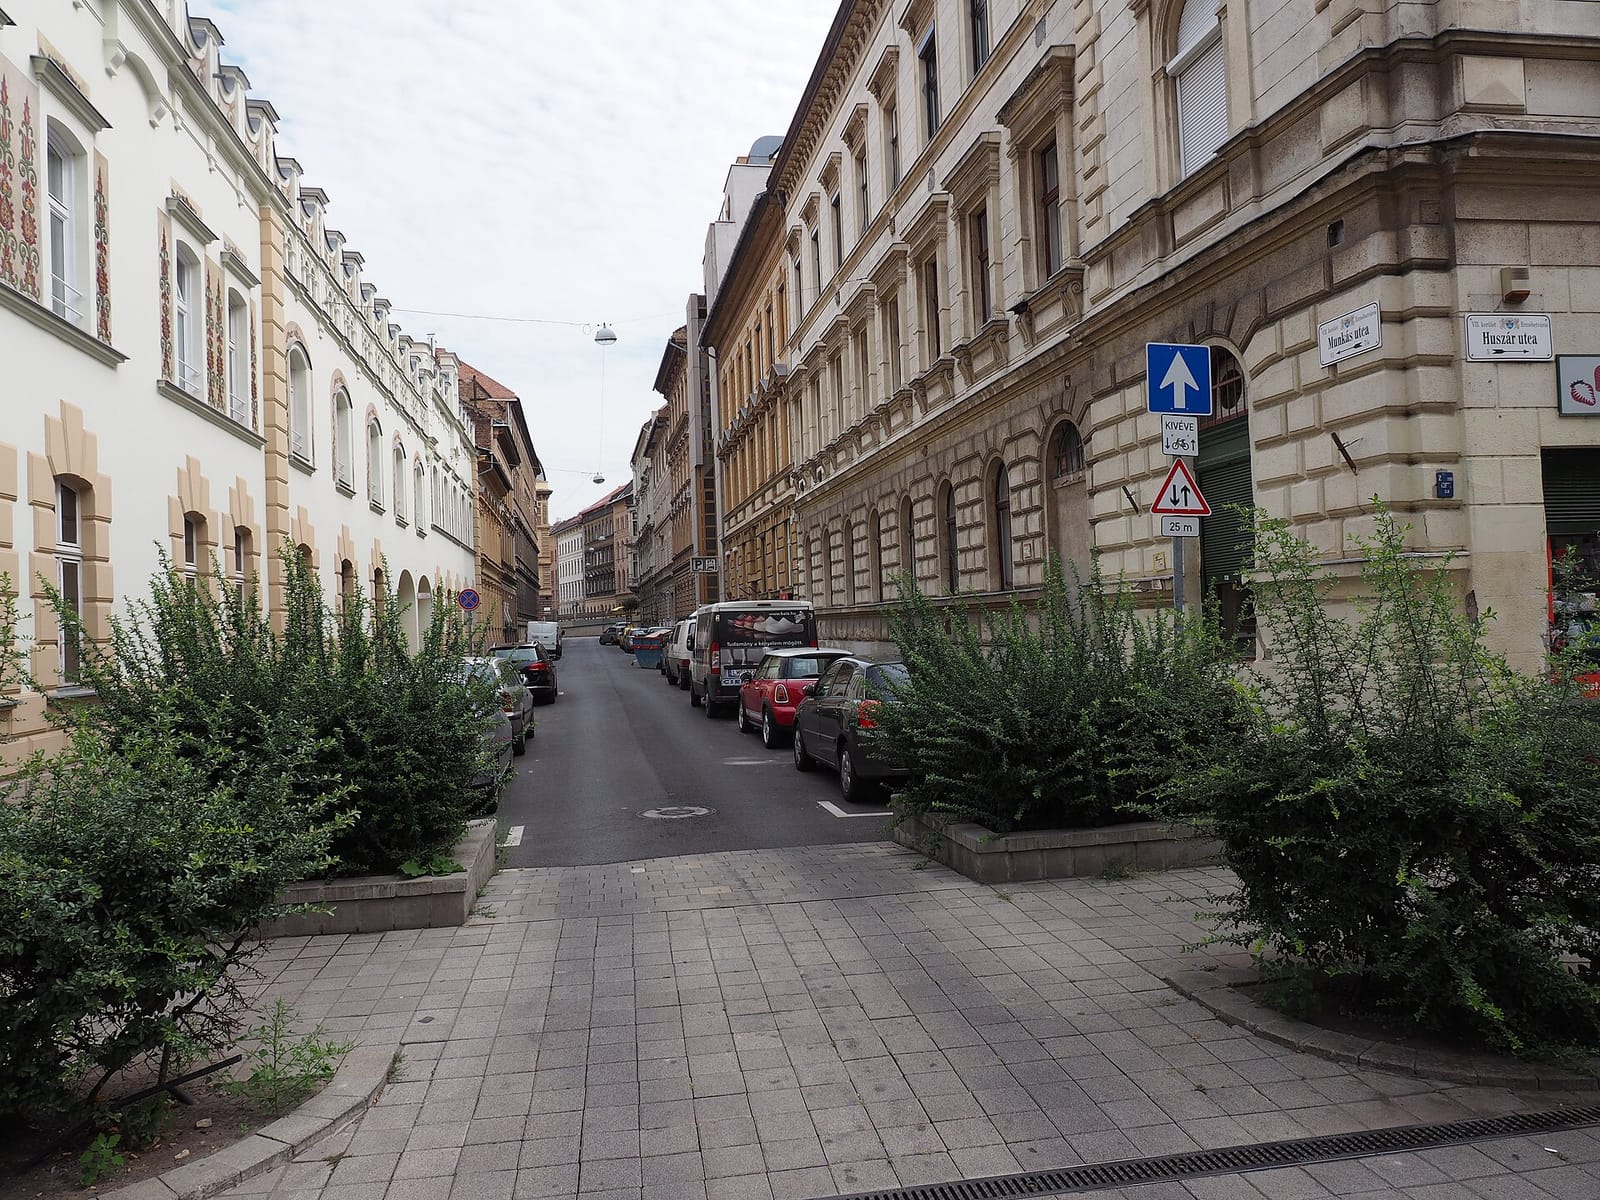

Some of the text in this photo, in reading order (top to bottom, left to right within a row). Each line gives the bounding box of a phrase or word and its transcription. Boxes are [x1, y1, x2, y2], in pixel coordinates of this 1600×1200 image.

[1328, 329, 1354, 349] Munkás
[1354, 326, 1369, 340] utca
[1482, 331, 1538, 345] Huszár utca
[1165, 420, 1195, 431] KIVÉVE
[1169, 522, 1193, 532] 25 m
